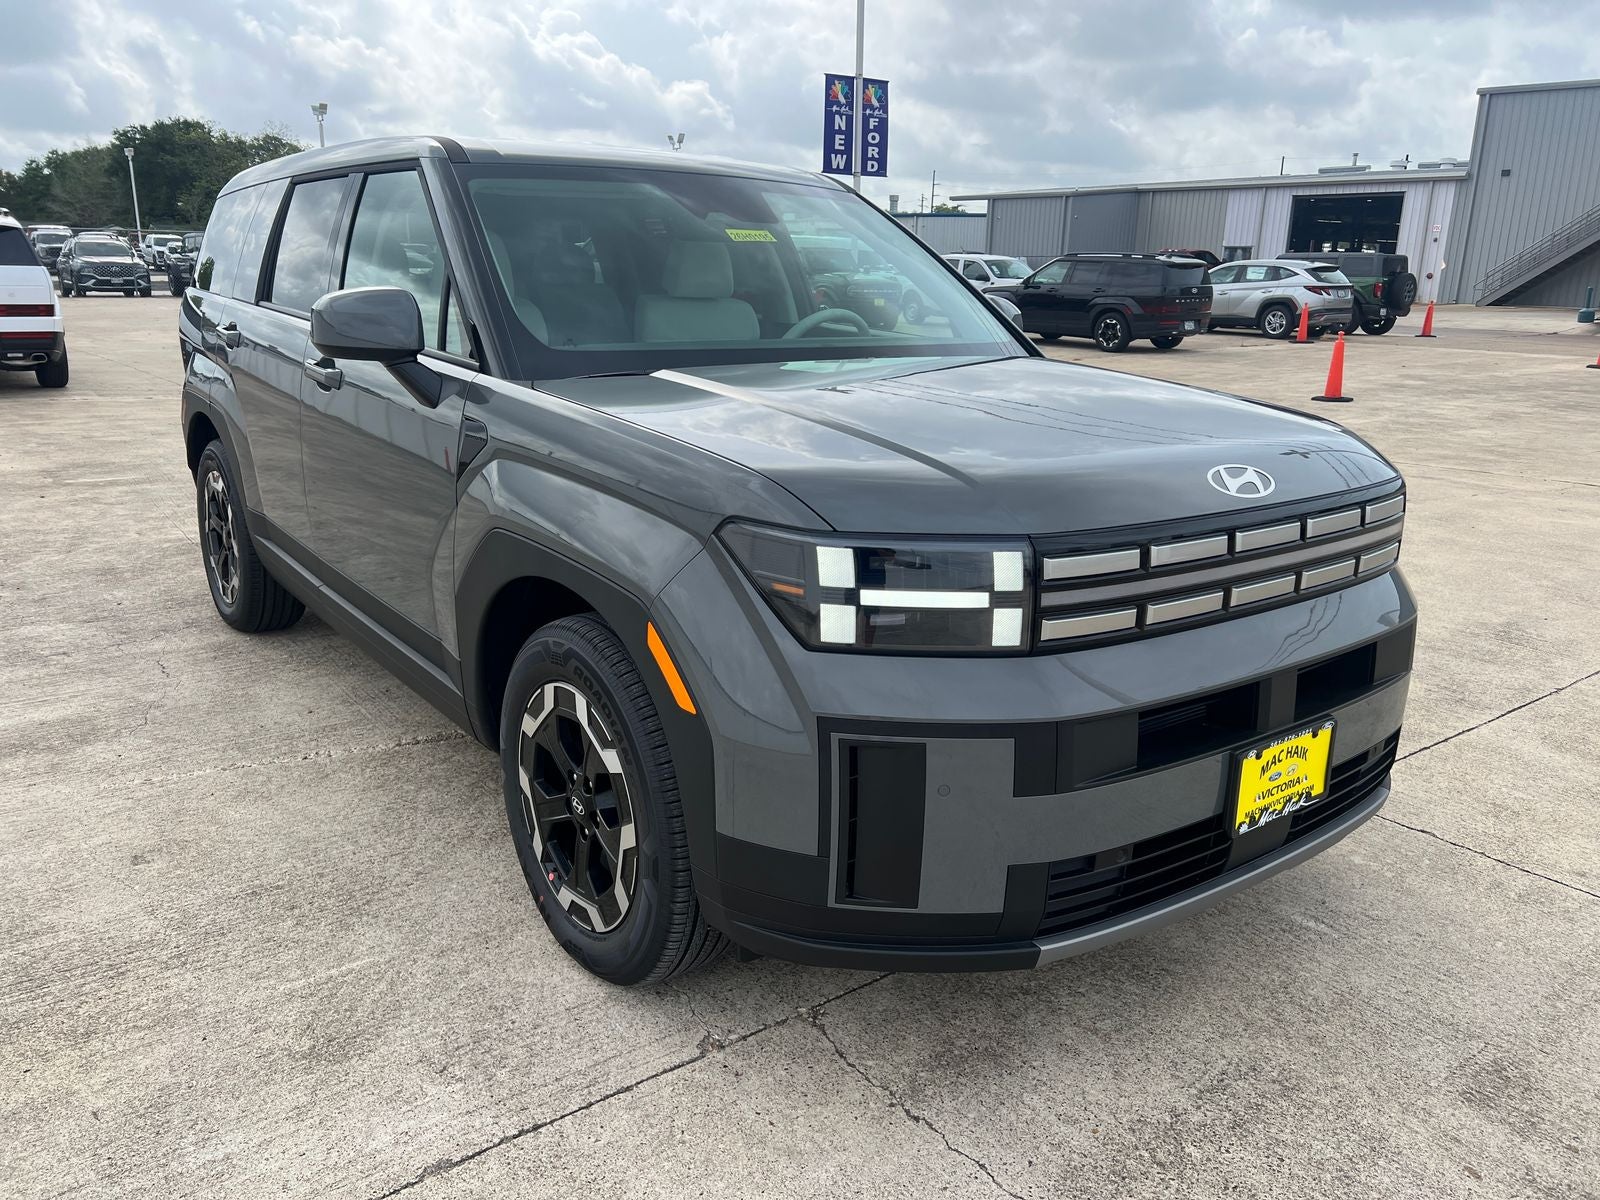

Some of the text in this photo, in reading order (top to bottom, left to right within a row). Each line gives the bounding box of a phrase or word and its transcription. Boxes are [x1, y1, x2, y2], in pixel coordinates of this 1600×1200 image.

[831, 114, 847, 170] NEW
[867, 117, 880, 172] FORD
[1259, 745, 1309, 779] MAC HAIK
[1260, 776, 1301, 800] VICTORIA
[1258, 793, 1319, 827] Mac Haik
